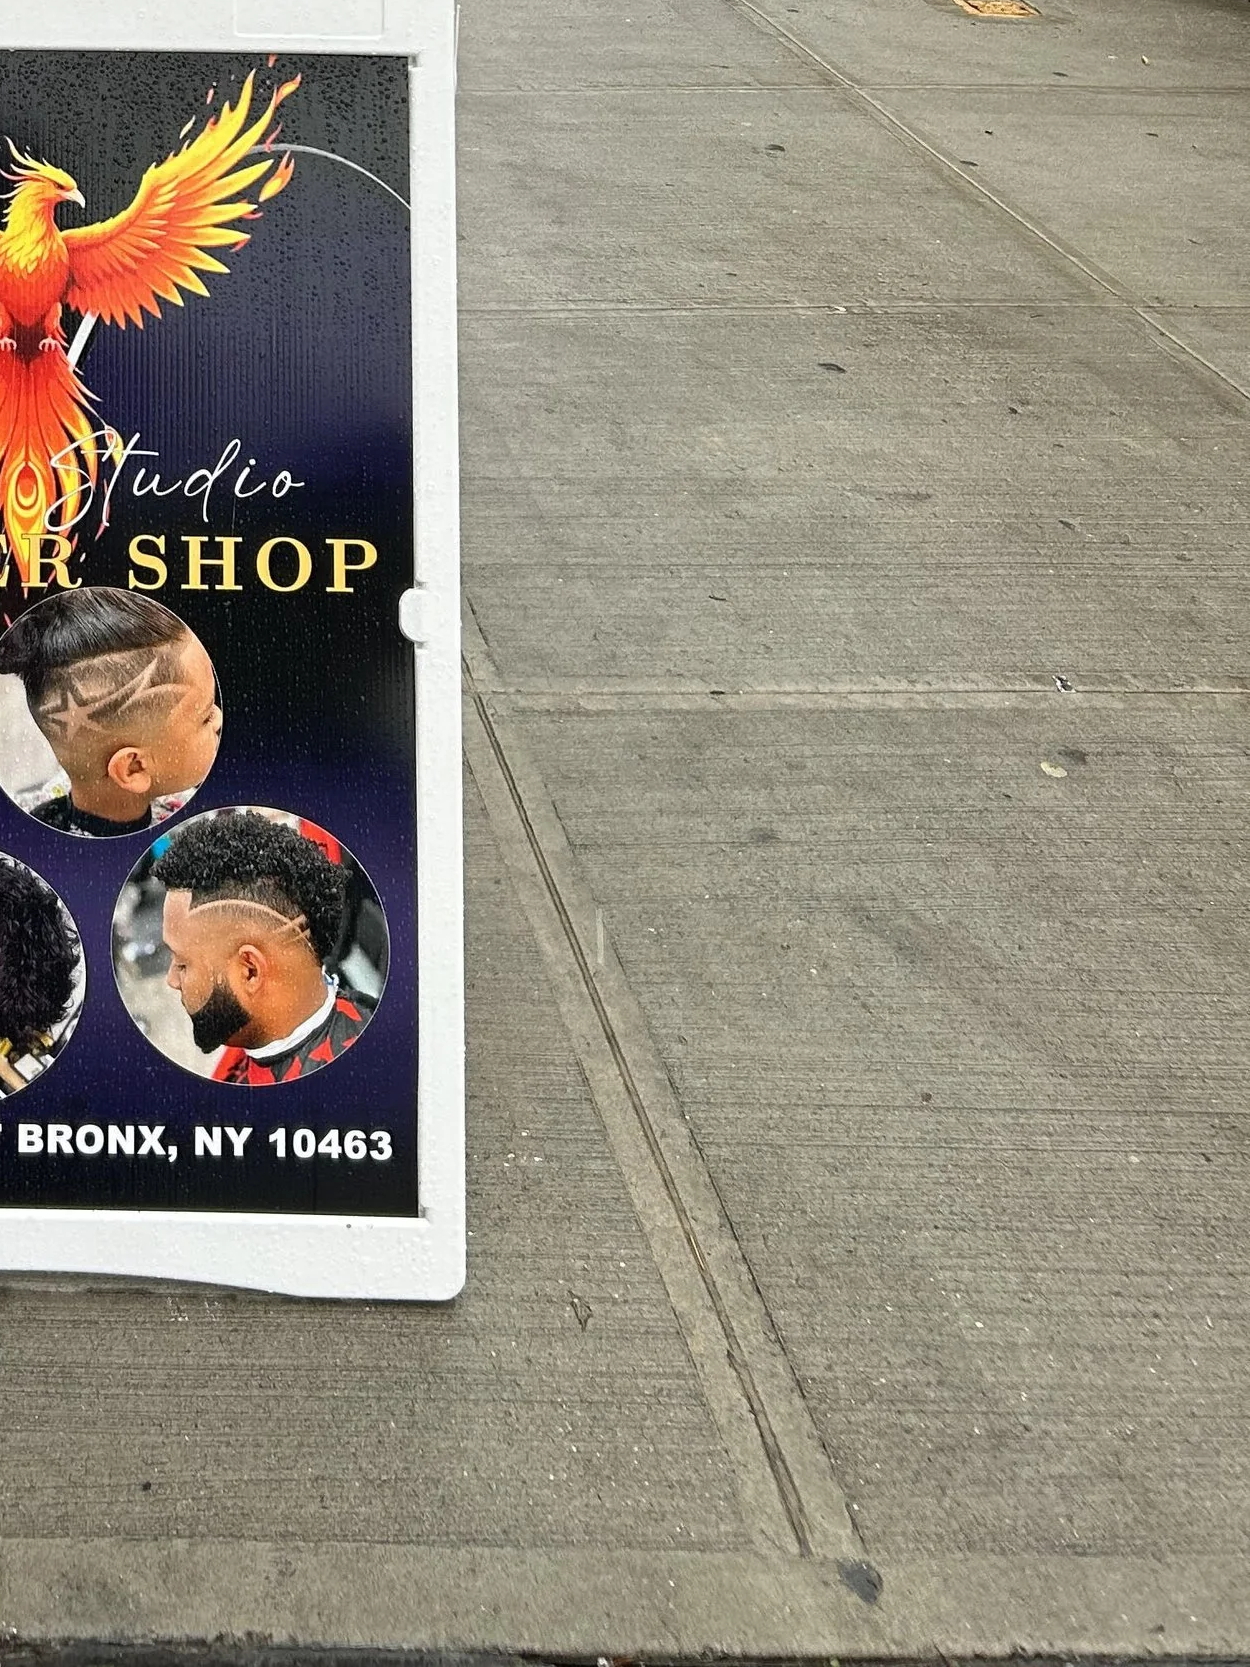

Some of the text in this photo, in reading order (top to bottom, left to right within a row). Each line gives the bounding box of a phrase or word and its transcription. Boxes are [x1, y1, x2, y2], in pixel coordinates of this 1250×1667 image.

[43, 429, 306, 532] Studio
[128, 534, 378, 593] SHOP
[17, 1124, 178, 1162] BRONX,
[194, 1126, 252, 1157] NY
[268, 1127, 393, 1161] 10463
